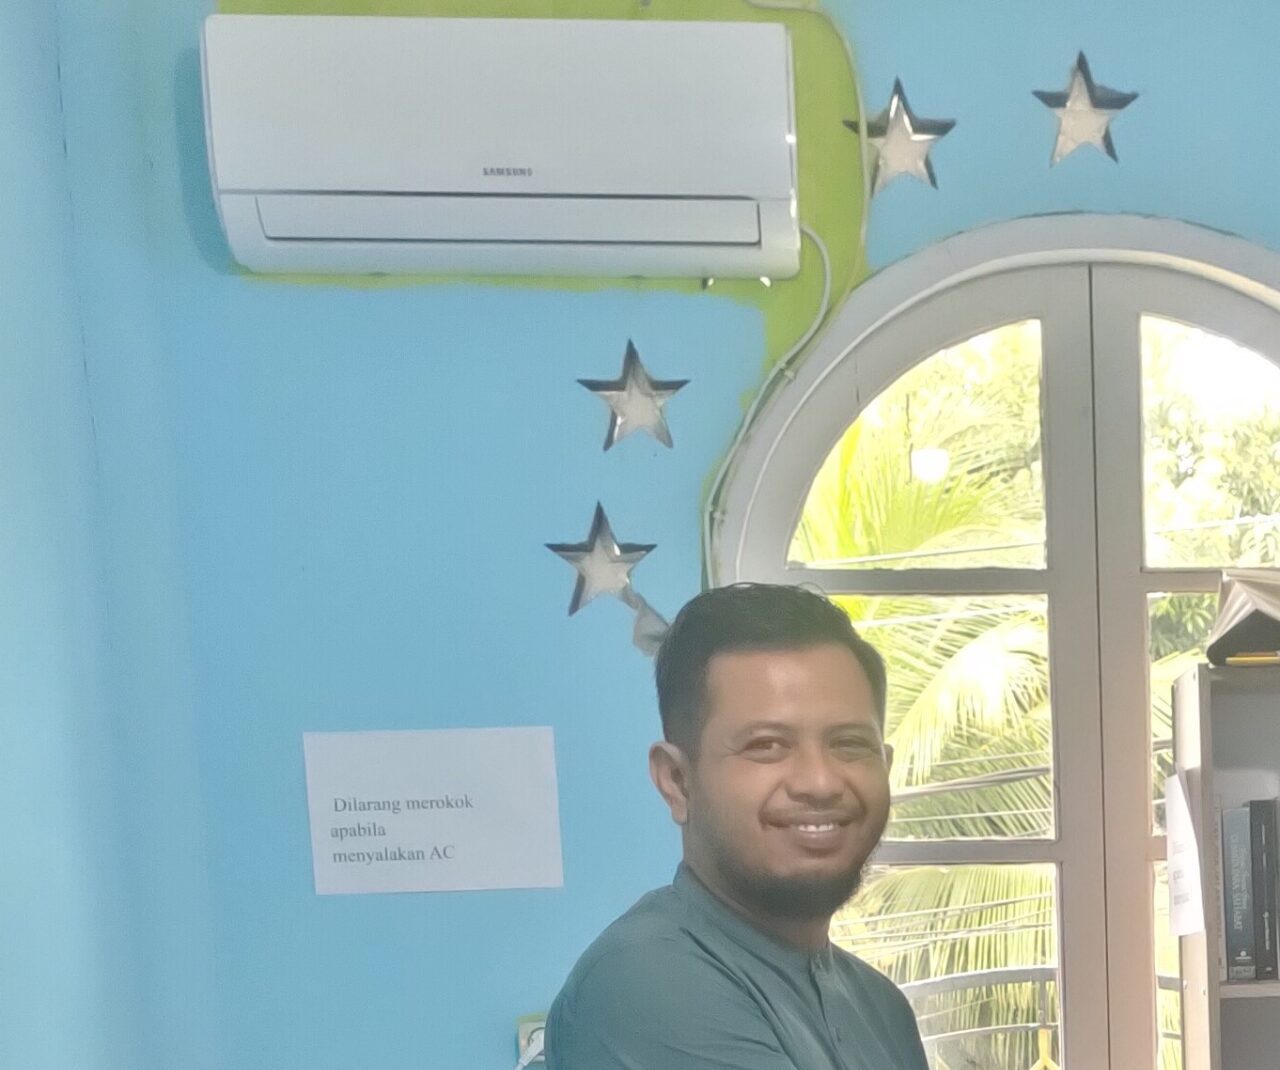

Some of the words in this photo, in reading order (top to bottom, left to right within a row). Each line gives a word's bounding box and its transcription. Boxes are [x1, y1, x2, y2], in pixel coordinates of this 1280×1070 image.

[482, 167, 534, 177] SAMSUNG
[333, 797, 402, 814] Dilarang
[406, 794, 474, 811] merokok
[330, 822, 387, 842] apabila
[332, 846, 426, 866] menyalakan
[429, 845, 456, 861] AC
